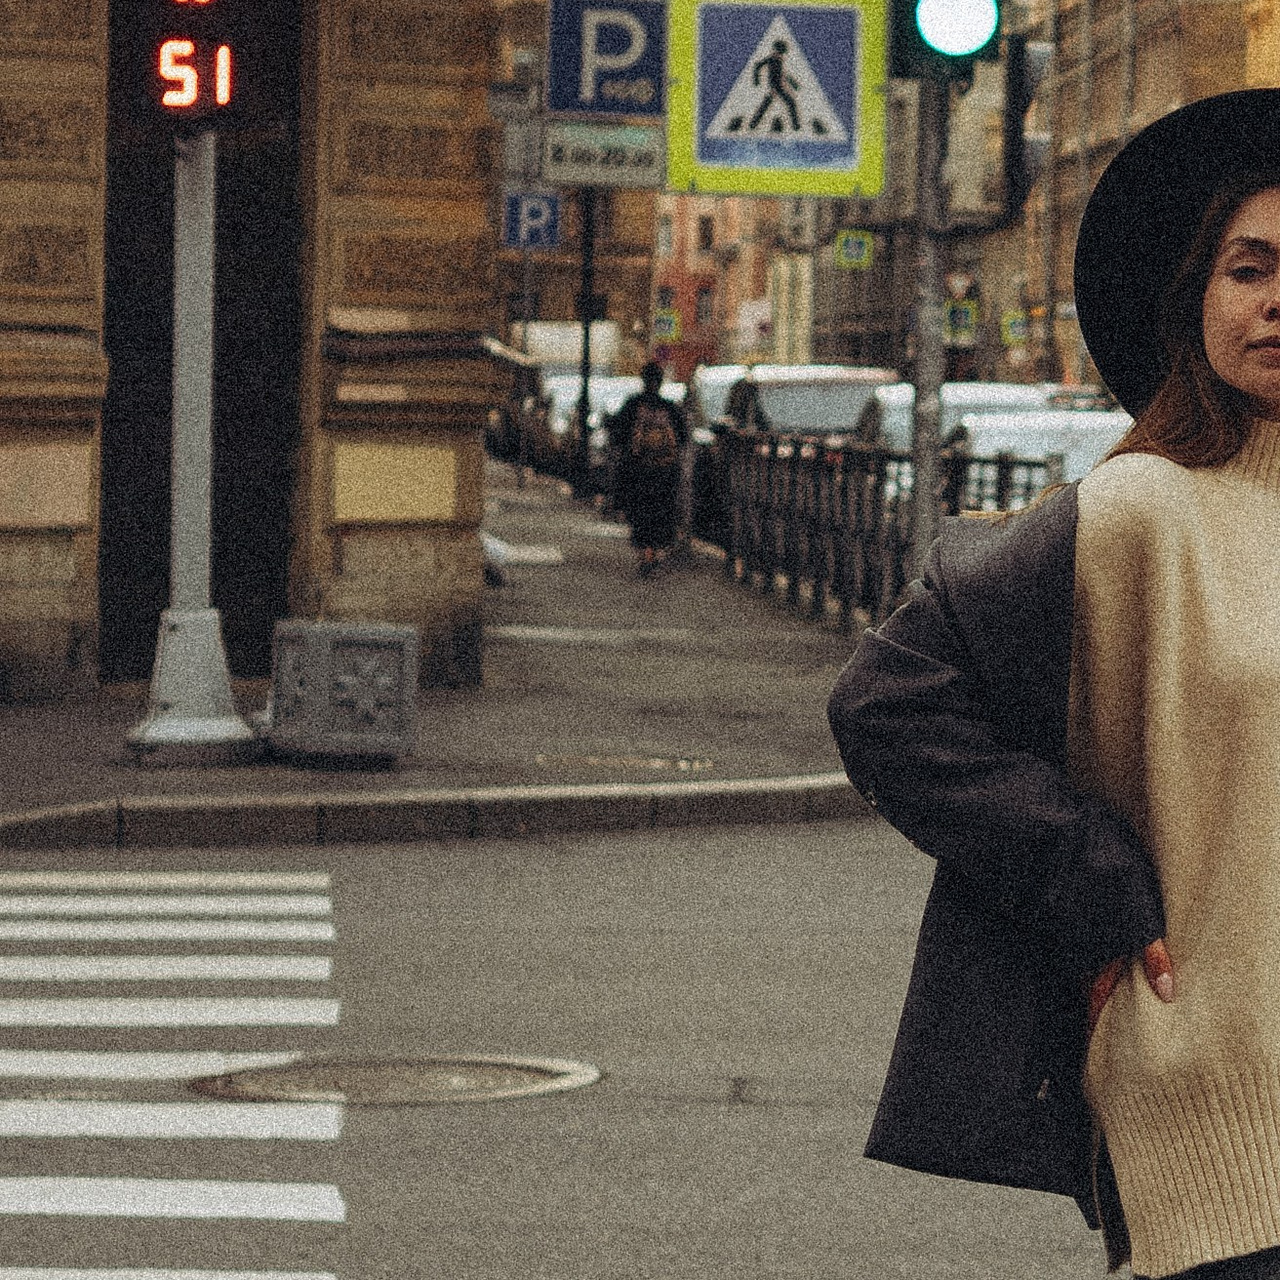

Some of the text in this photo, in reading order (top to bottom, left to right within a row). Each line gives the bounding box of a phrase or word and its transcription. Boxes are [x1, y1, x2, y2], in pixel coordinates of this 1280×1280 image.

[159, 39, 231, 106] 51
[578, 8, 647, 102] P
[519, 198, 549, 241] P
